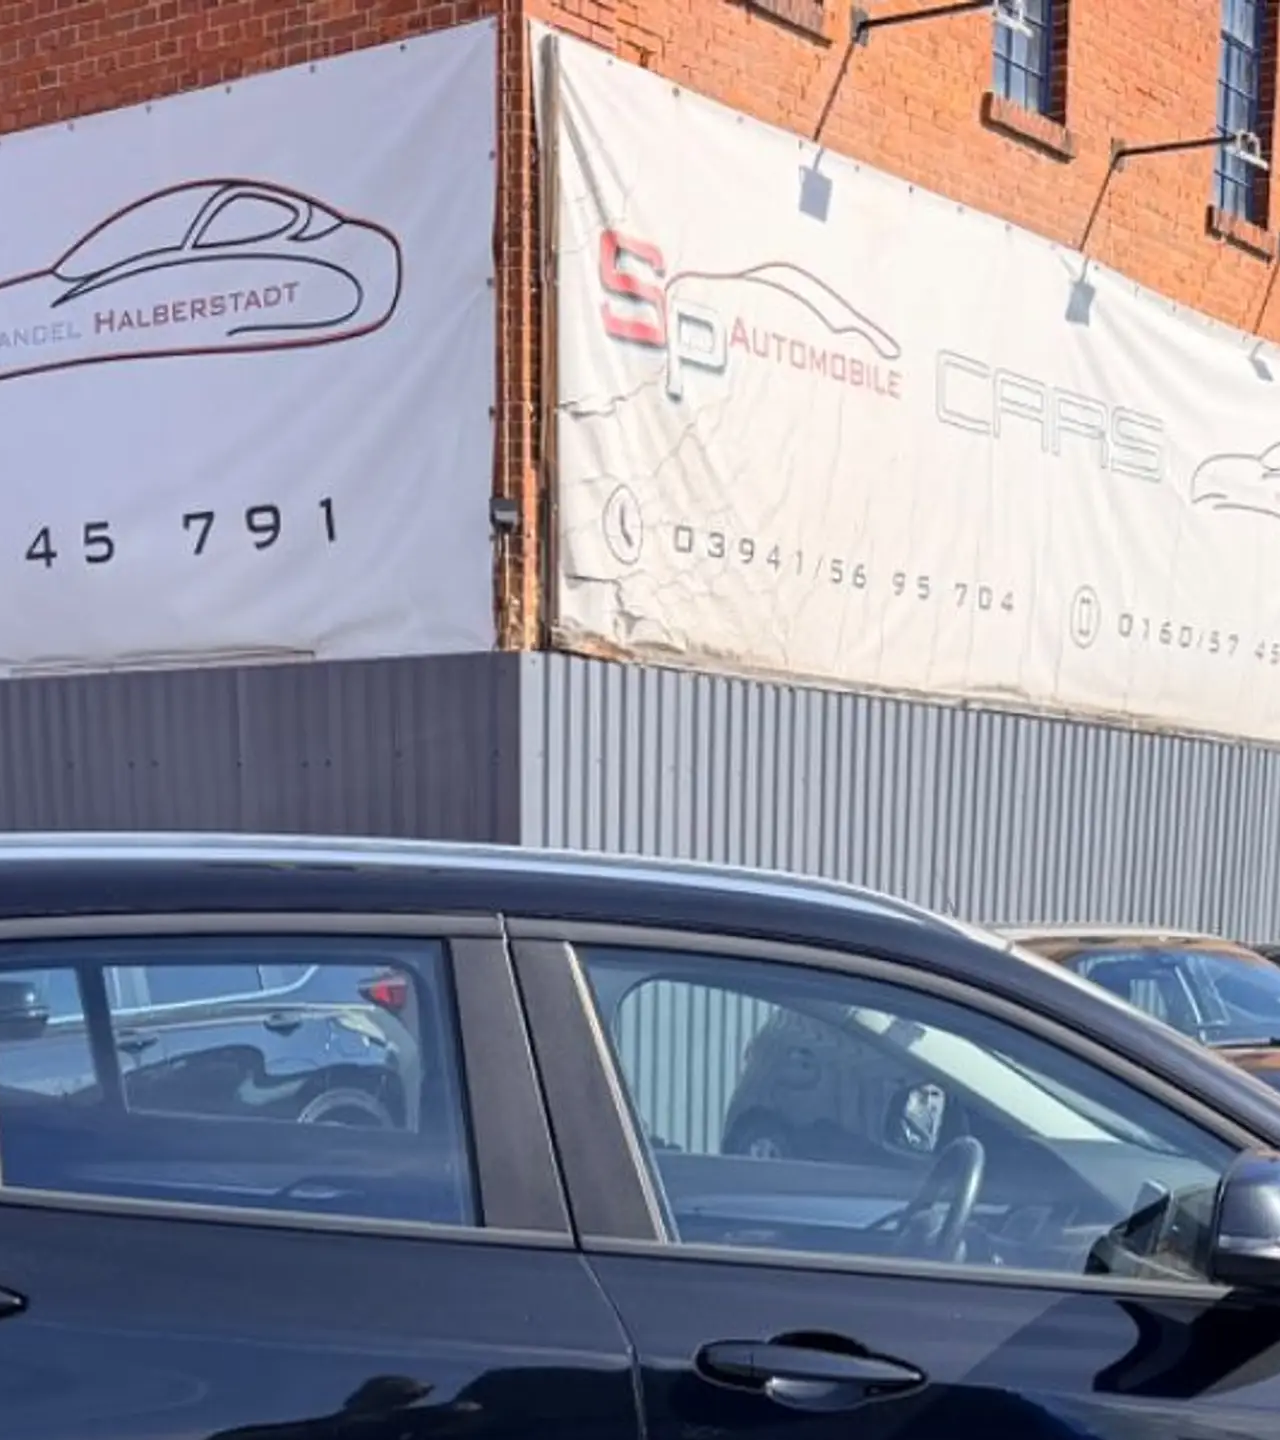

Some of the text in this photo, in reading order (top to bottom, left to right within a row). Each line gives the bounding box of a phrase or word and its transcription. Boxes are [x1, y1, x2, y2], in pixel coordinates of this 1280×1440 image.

[94, 281, 300, 335] HALBERSTADT
[936, 349, 1163, 482] CARS
[25, 521, 115, 569] 45
[182, 497, 338, 557] 791
[673, 525, 868, 589] 03941/56
